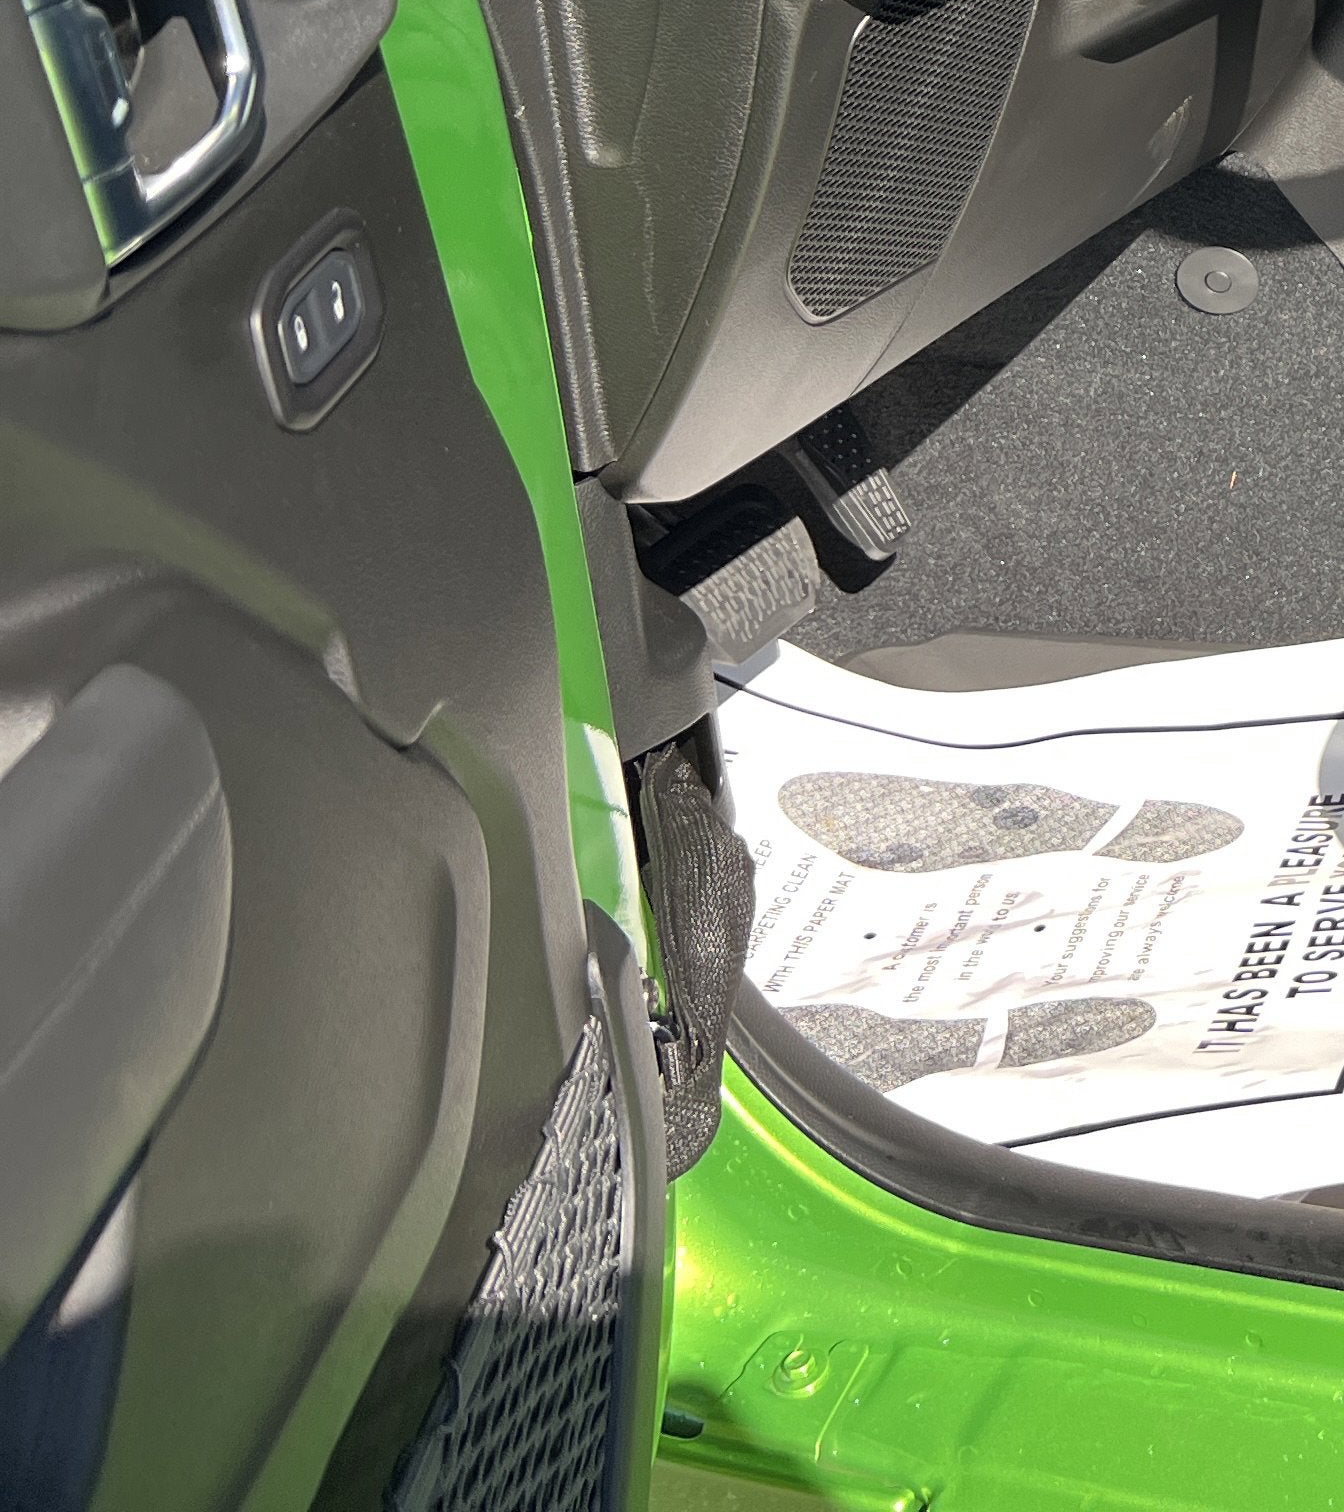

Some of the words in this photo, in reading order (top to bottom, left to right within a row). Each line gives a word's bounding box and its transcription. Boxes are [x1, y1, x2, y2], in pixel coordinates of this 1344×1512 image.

[783, 853, 818, 893] CLEAN
[1260, 890, 1306, 907] A
[763, 964, 793, 993] WITH
[784, 934, 813, 961] THIS
[803, 896, 838, 935] PAPER
[829, 871, 856, 895] MAT
[1231, 919, 1297, 983] BEEN
[1285, 970, 1338, 999] TO
[1207, 988, 1269, 1033] HAS
[1192, 1039, 1246, 1054] IT
